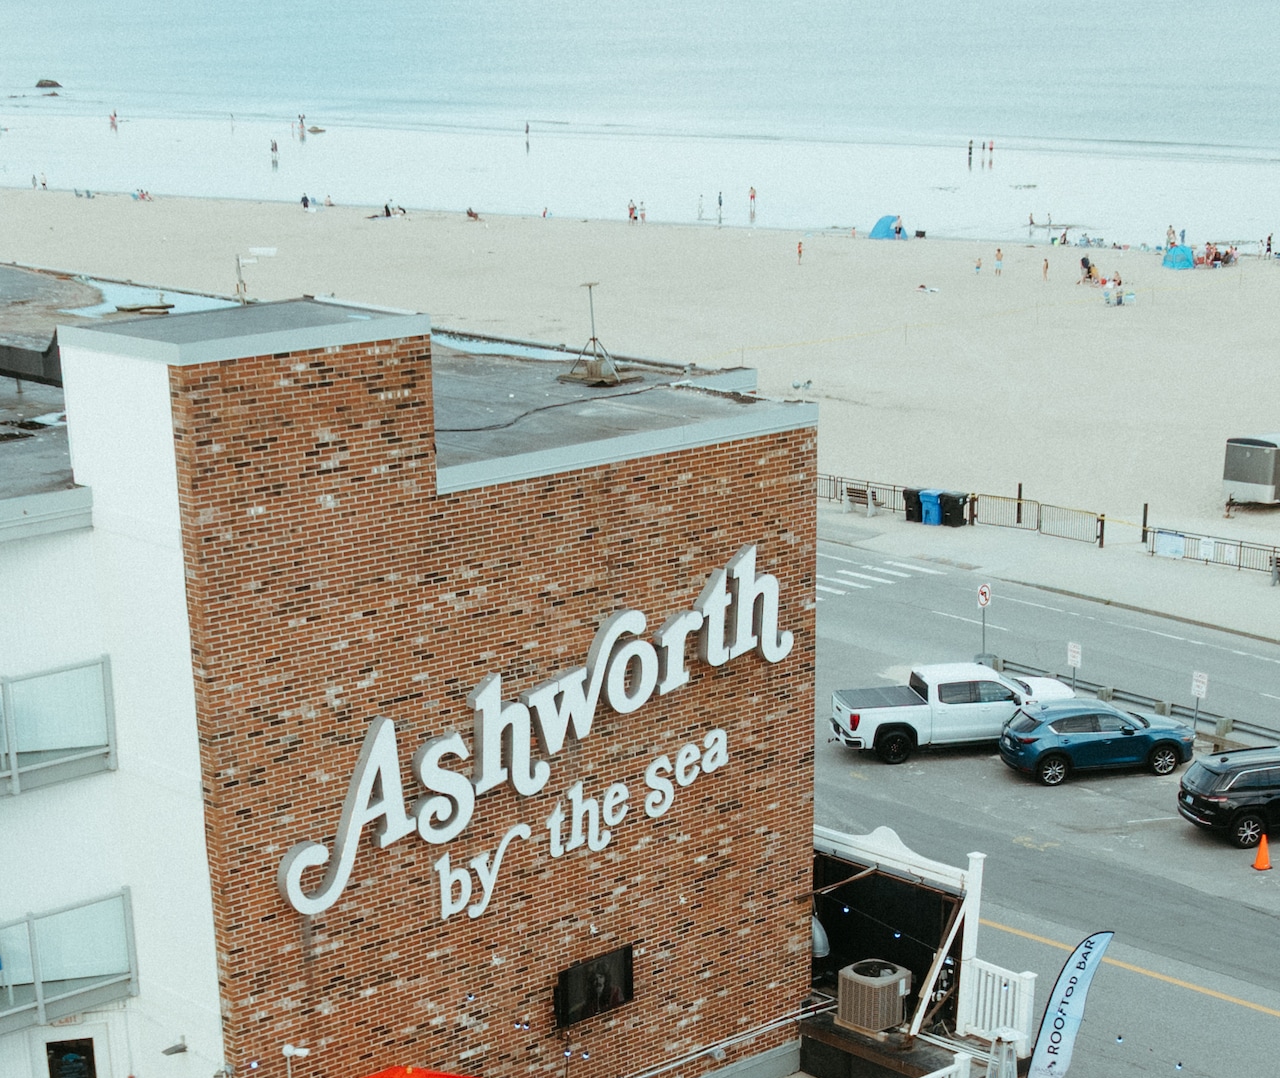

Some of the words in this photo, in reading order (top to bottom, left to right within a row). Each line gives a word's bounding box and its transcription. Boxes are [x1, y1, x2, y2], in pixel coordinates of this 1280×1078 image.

[278, 544, 794, 915] Ashworth
[434, 823, 531, 920] by
[545, 781, 630, 859] the
[643, 728, 729, 819] sea
[1076, 939, 1095, 971] BAR
